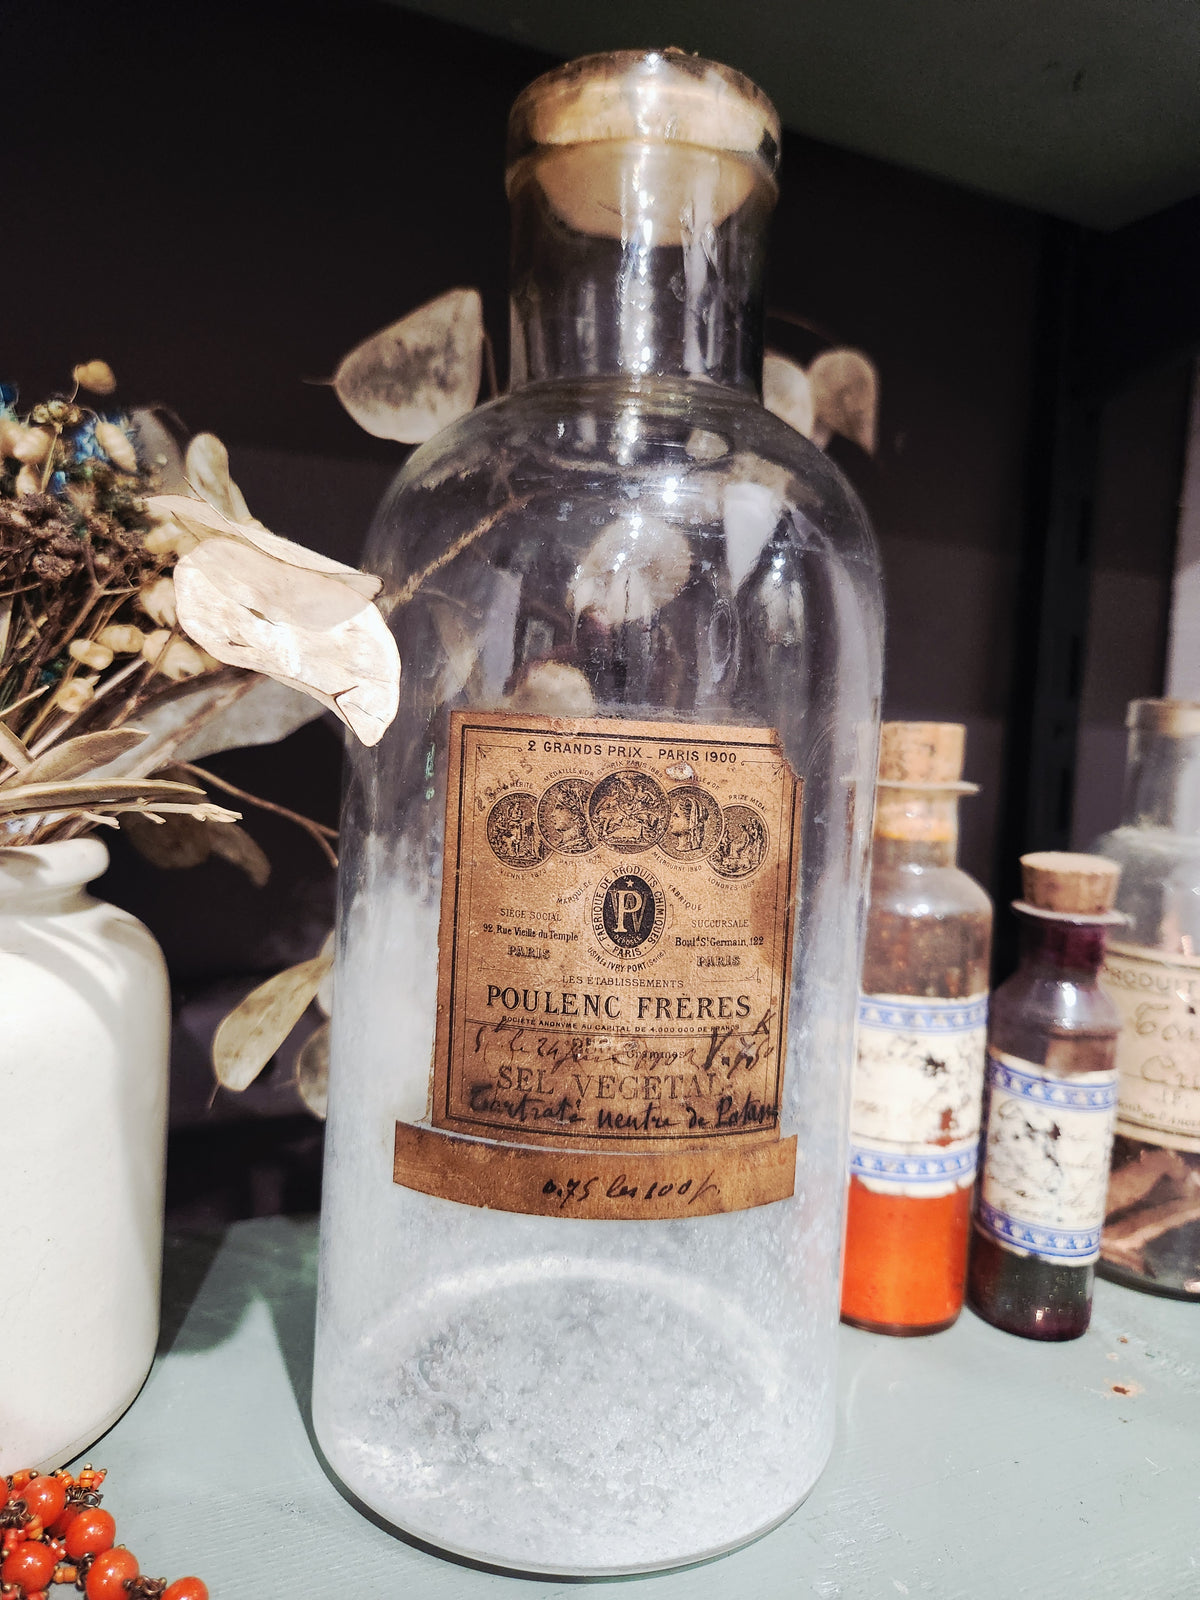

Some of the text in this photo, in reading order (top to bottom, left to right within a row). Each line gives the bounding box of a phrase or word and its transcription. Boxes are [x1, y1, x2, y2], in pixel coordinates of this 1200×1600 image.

[527, 740, 537, 752] 2
[543, 741, 602, 756] GRANDS
[607, 745, 643, 758] PRIX
[658, 748, 700, 761] PARIS
[705, 751, 737, 763] 1900
[668, 884, 702, 911] FABRIQUE
[529, 911, 562, 922] SOCIAL
[593, 865, 665, 958] FABRIQUE DE PRODUITS CHIMIQUES PARIS
[691, 919, 749, 928] SUCCURSALE
[496, 924, 512, 935] Rue
[538, 930, 548, 939] du
[549, 930, 579, 943] Temple
[507, 944, 551, 960] PARIS
[696, 955, 741, 968] PARIS
[562, 975, 583, 985] LES
[486, 984, 752, 1021] POULENC FRÈRES
[538, 1020, 577, 1030] ANONYME
[595, 1024, 631, 1032] CAPITAL
[497, 1065, 554, 1095] SEL
[686, 1105, 710, 1129] de
